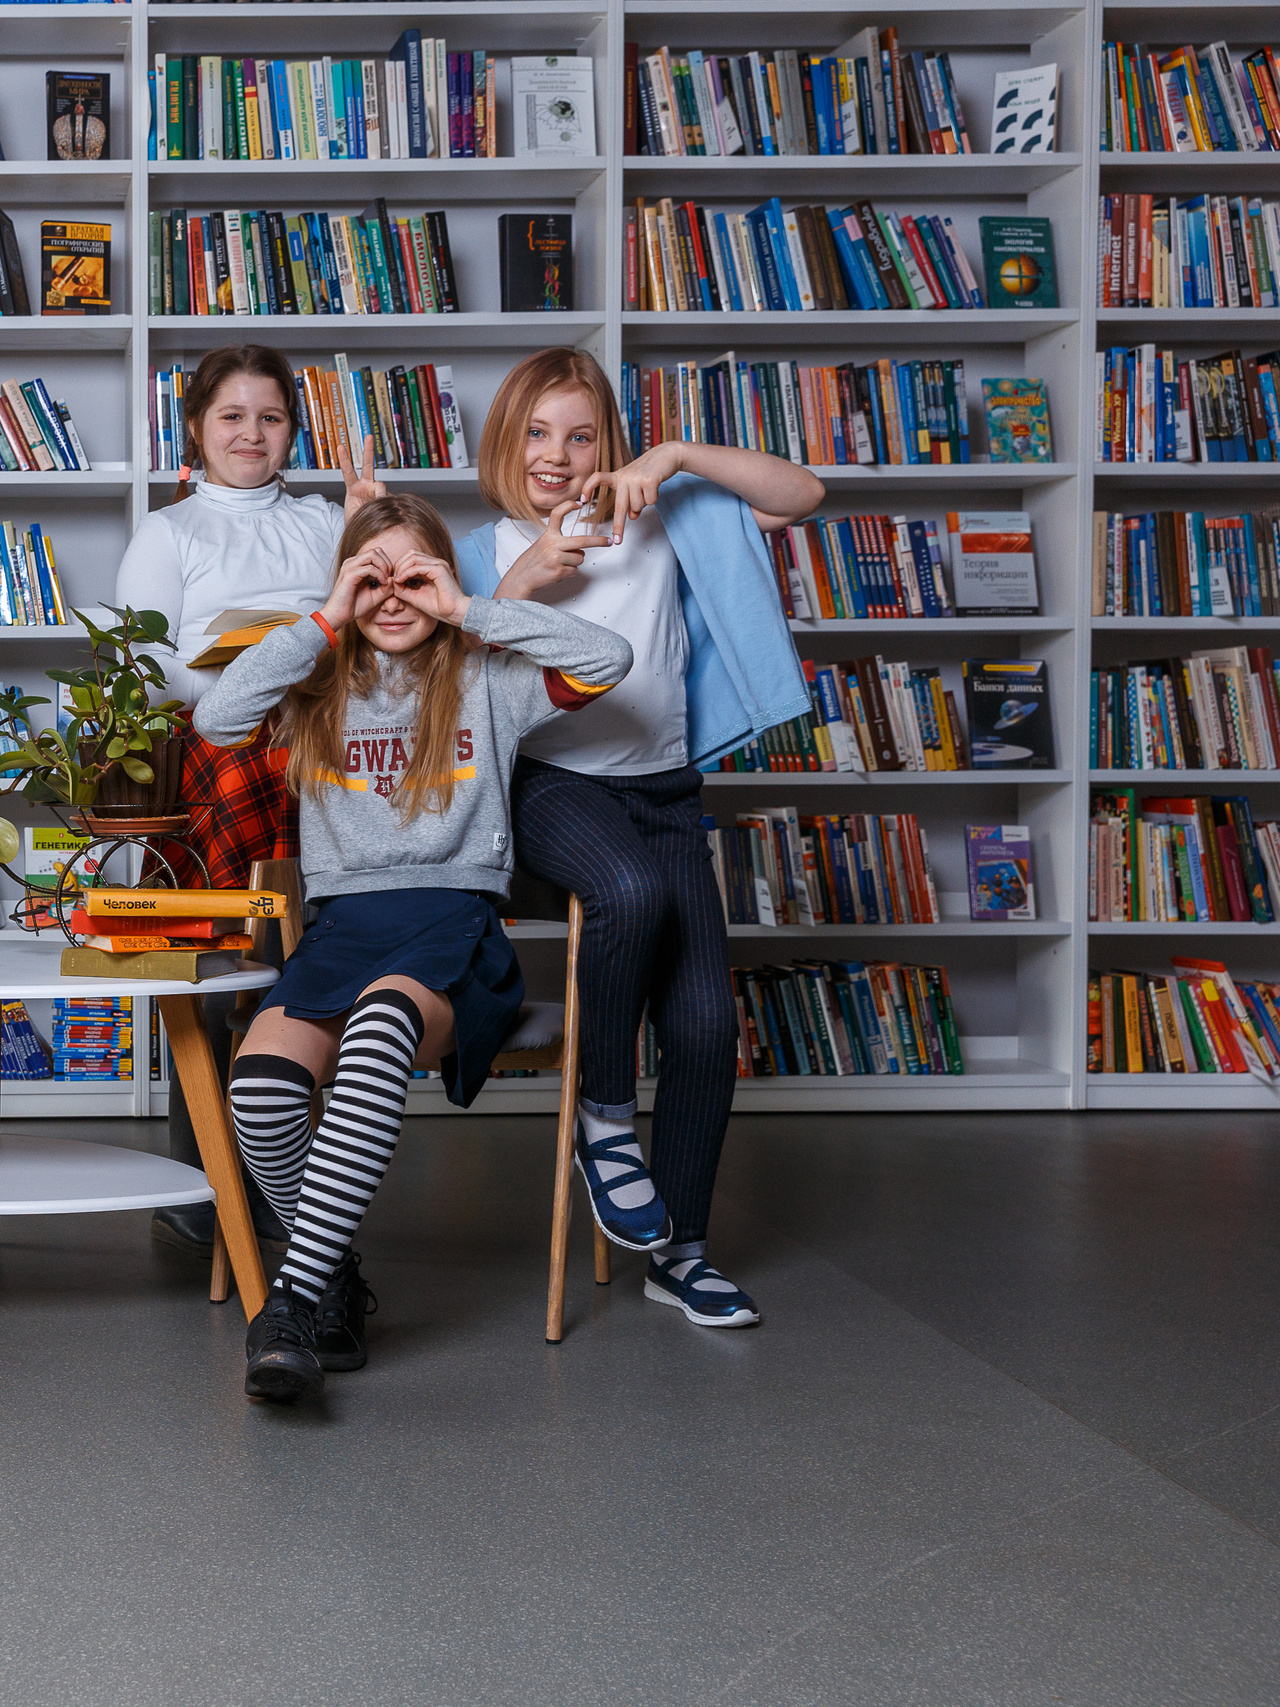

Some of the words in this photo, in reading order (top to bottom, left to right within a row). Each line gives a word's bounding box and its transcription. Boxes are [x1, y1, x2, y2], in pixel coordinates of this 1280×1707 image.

[408, 41, 418, 81] ГЕНЕТИКОЙ
[169, 80, 180, 123] БИОЛОГИЯ
[410, 82, 419, 108] ОБЩЕЙ
[235, 77, 248, 156] БИОЛОГИЯ
[315, 98, 327, 137] БИОЛОГИЯ
[412, 113, 422, 148] БИОЛОГИЯ
[302, 124, 311, 153] БИОЛОГИЯ
[51, 239, 105, 248] ГЕОГРАФИЧЕСКИХ
[70, 225, 105, 233] КРАТКАЯ
[70, 232, 105, 240] ИСТОРИЯ
[861, 205, 892, 271] Гидравлика
[71, 246, 105, 254] ОТКРЫТИЙ
[371, 228, 383, 266] БИОРИТМЫ
[1110, 234, 1121, 291] Internet
[414, 232, 434, 309] БИОЛОГИЯ
[298, 388, 310, 431] МИКРОБИОЛОГИЯ
[1113, 394, 1121, 407] XP
[49, 411, 66, 448] ЕВРОПА
[1113, 408, 1122, 443] Windows
[963, 559, 999, 569] Теория
[963, 571, 1029, 581] информации
[973, 681, 1005, 693] Банки
[1006, 683, 1044, 693] данных
[361, 727, 404, 736] WITCHCRAFT
[345, 728, 474, 773] GWAS
[103, 898, 157, 910] Человек
